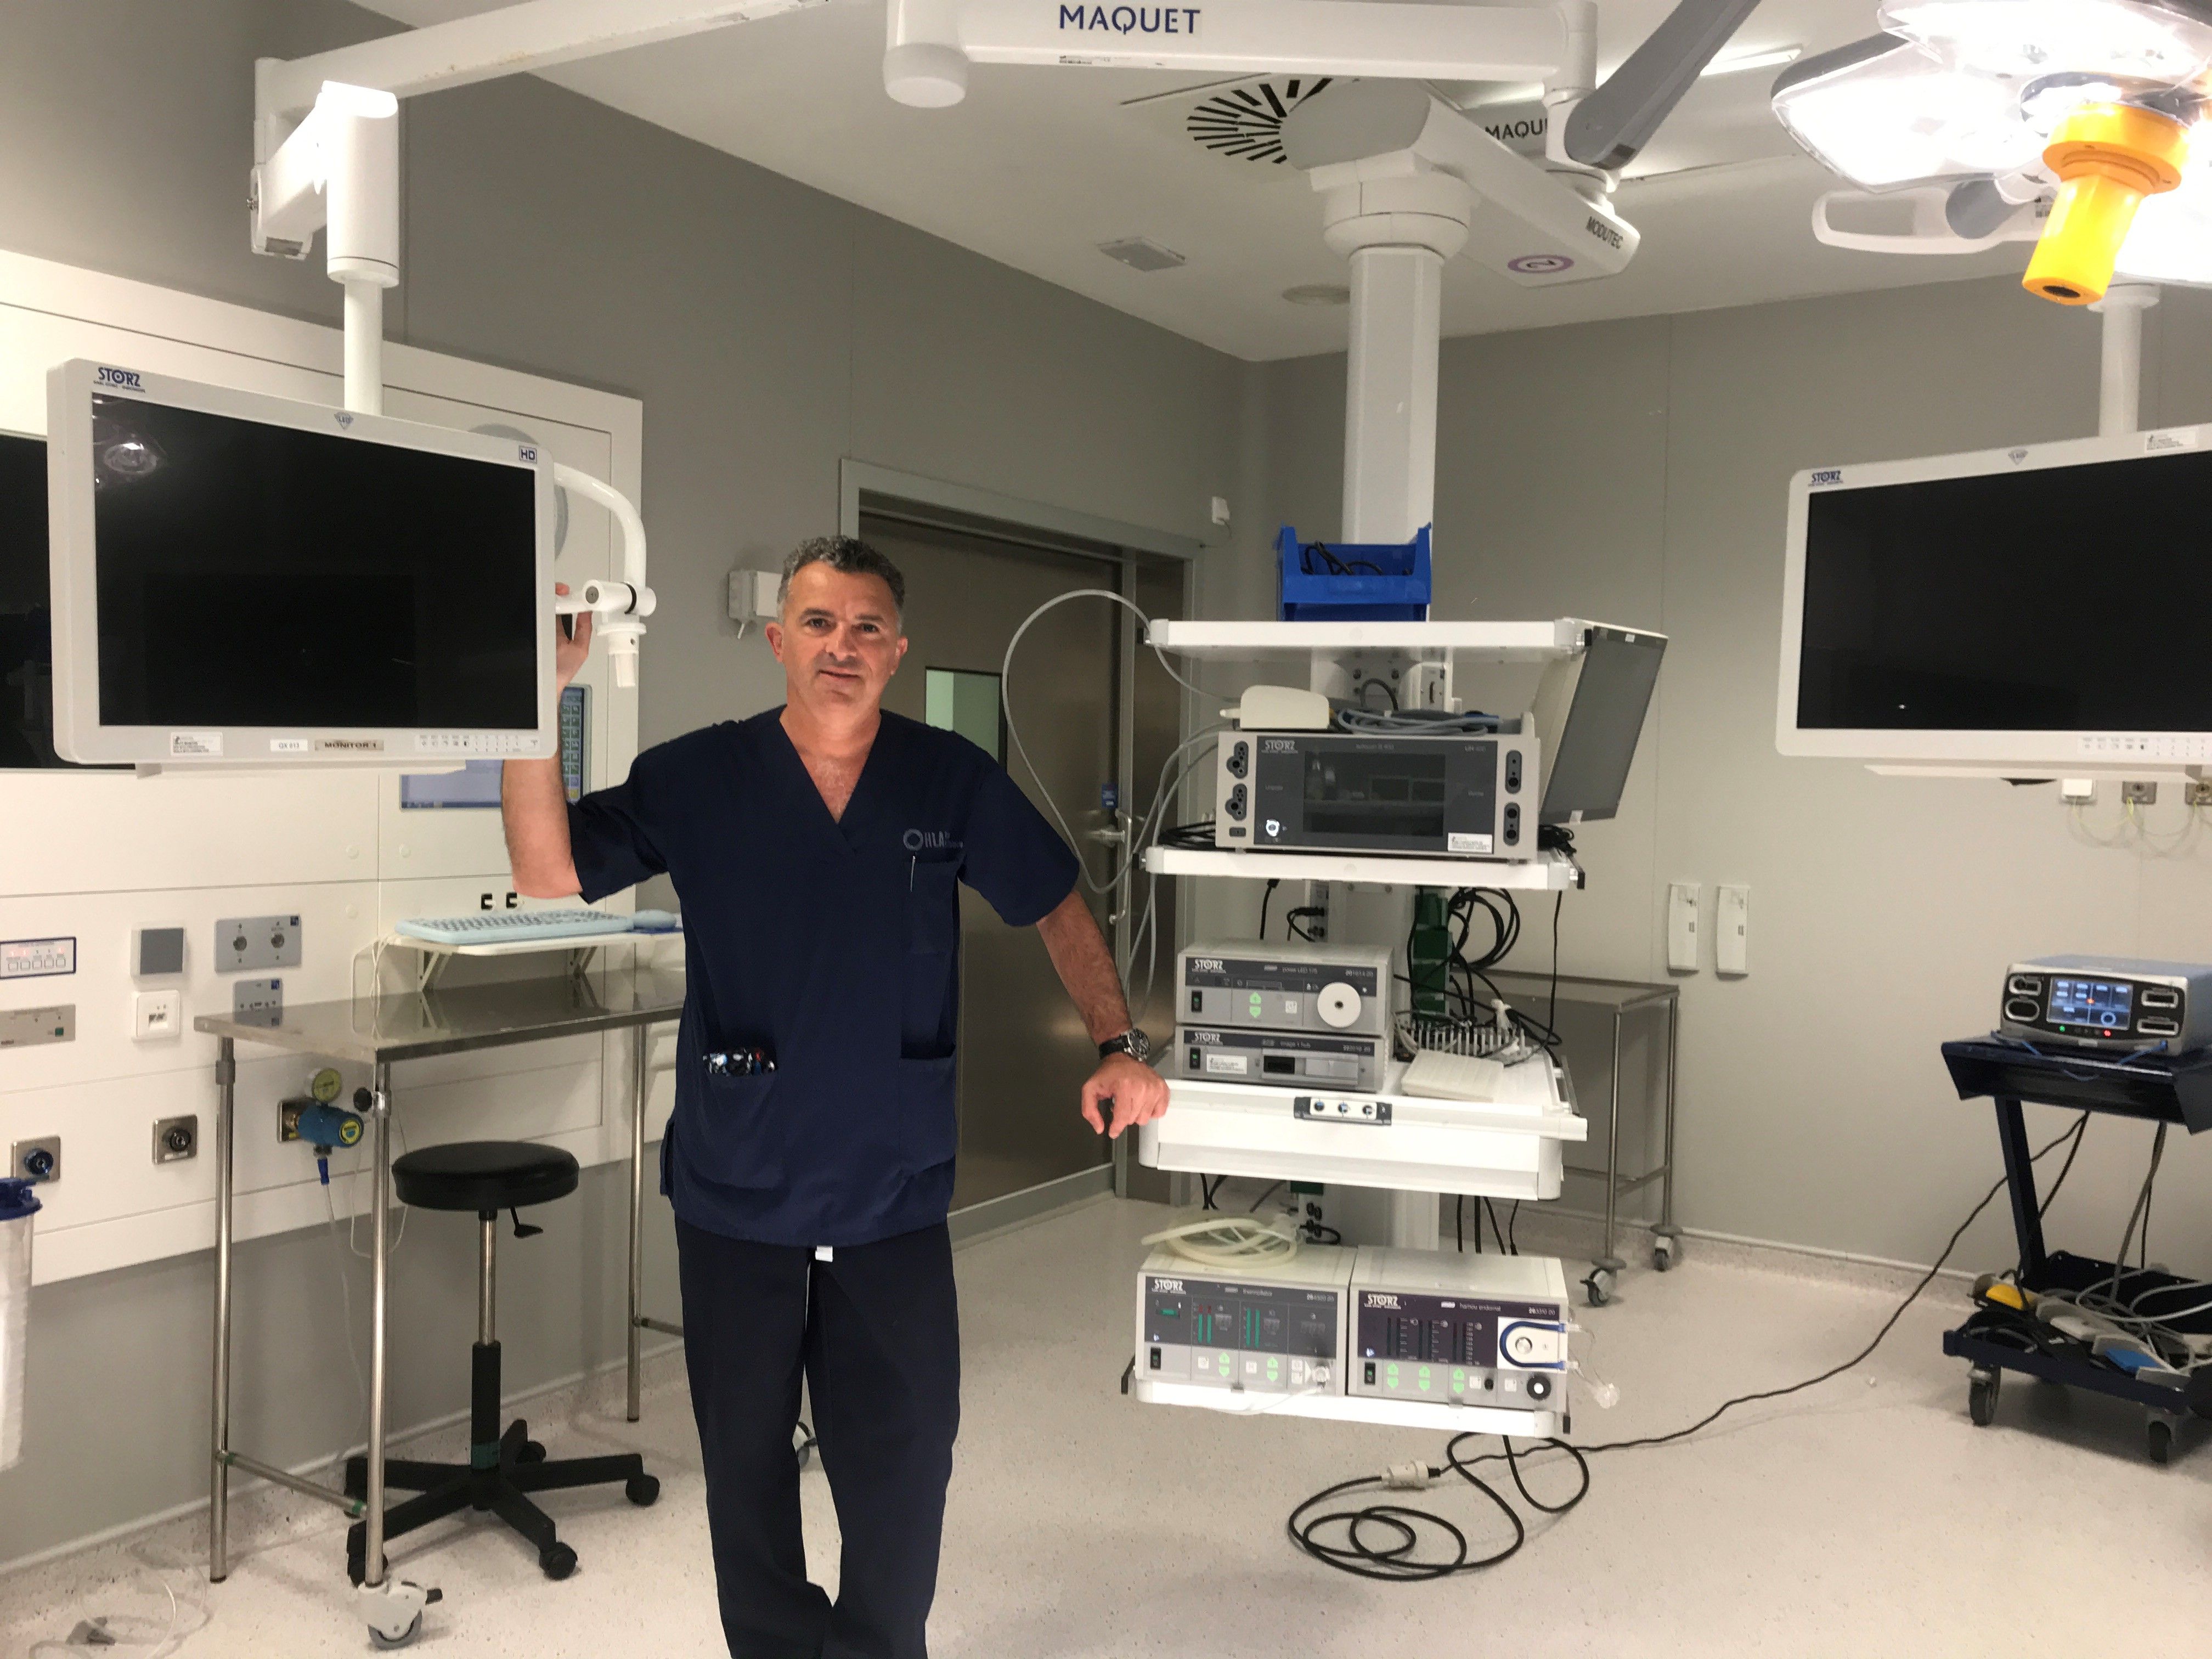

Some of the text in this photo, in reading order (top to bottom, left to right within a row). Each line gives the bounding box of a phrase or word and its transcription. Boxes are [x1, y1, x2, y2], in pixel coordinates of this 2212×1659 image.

[1060, 4, 1200, 35] MAQUET
[1585, 216, 1623, 250] MODUTEC
[98, 366, 140, 387] STORZ
[521, 449, 535, 460] HD
[1812, 470, 1841, 482] STORZ
[1265, 740, 1295, 751] STORZ
[1194, 958, 1223, 970] STORZ
[1194, 1032, 1221, 1042] STORZ
[1154, 1278, 1183, 1291] STORZ
[1368, 1293, 1398, 1306] STORZ
